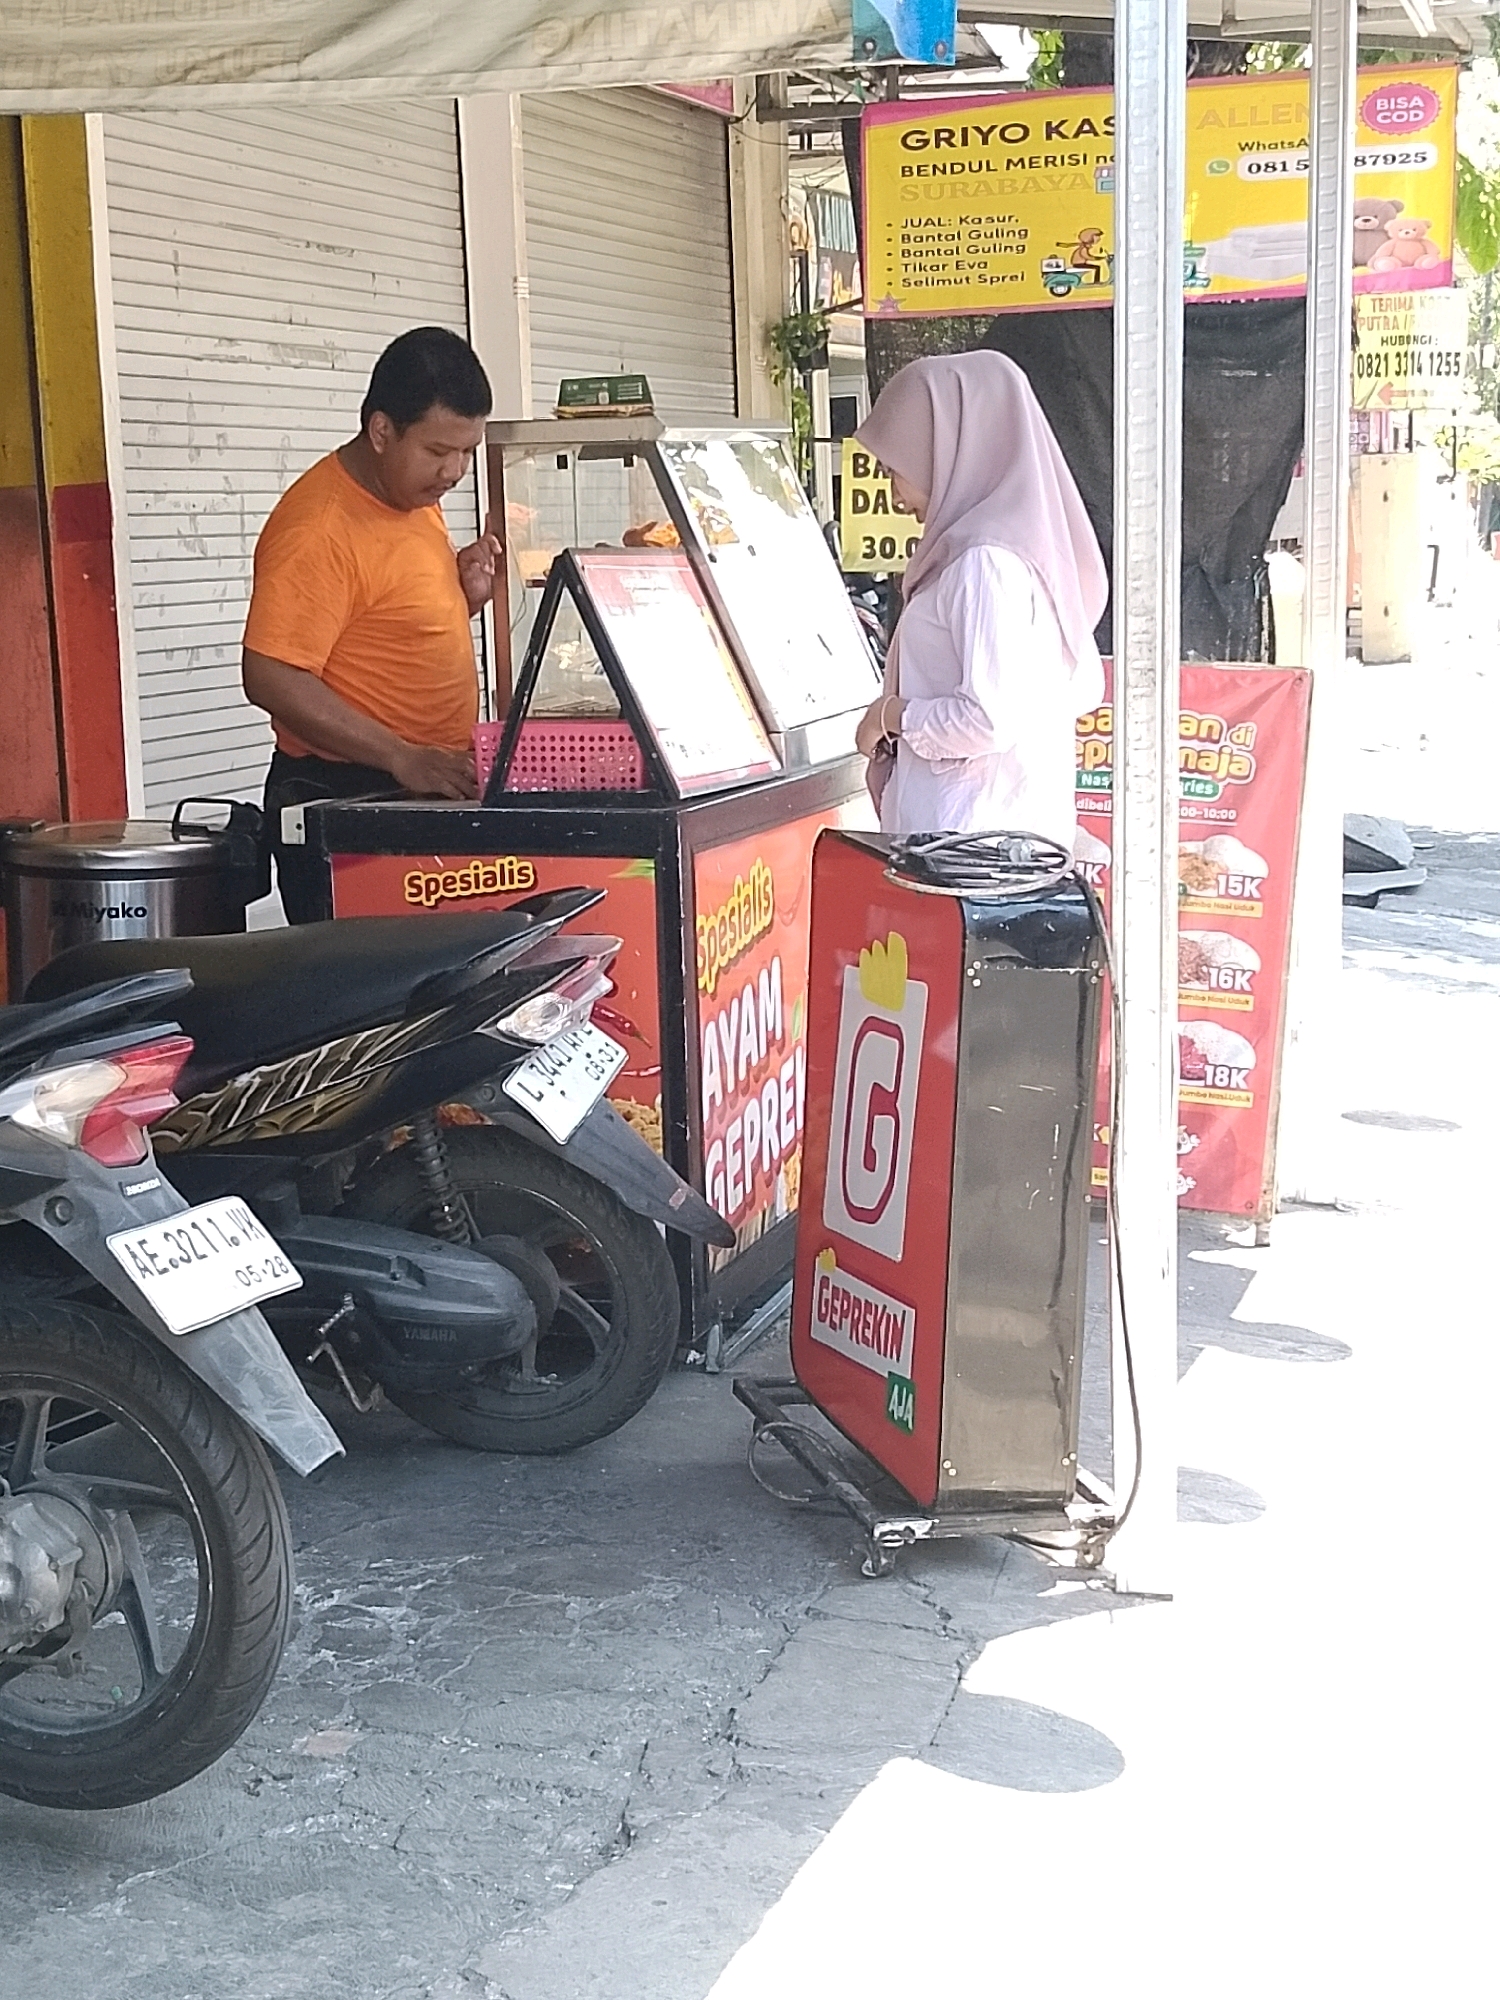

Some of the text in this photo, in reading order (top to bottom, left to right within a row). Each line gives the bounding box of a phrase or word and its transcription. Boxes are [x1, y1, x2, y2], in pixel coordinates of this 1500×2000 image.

[1376, 96, 1424, 111] BISA
[1376, 110, 1424, 124] COD
[900, 122, 1031, 151] GRIYO
[901, 159, 998, 178] BENDUL
[1005, 153, 1088, 171] MERISI
[1354, 151, 1427, 168] 87925
[900, 172, 1093, 201] SURABAYA
[901, 217, 952, 229] JUAL:
[901, 228, 1028, 244] Bantal Guling
[901, 243, 1026, 259] Bantal Guling
[901, 259, 988, 273] Tikar Eva
[901, 271, 1025, 288] Selimut Sprei
[1371, 296, 1414, 313] TERIMA
[1358, 314, 1400, 331] PUTRA
[1357, 352, 1388, 379] 0821
[1429, 350, 1460, 377] 1255
[1230, 725, 1253, 747] di
[406, 857, 532, 905] Spesialis
[1217, 874, 1264, 899] 15K
[697, 859, 773, 992] Spesialis
[1207, 966, 1253, 992] 16K
[702, 956, 782, 1122] AYAM
[1204, 1064, 1249, 1090] 18K
[517, 1081, 544, 1102] L
[841, 1015, 905, 1225] G
[124, 1238, 169, 1279] AE
[163, 1217, 233, 1264] 3211
[817, 1275, 906, 1363] GEPREKIN
[888, 1383, 913, 1431] AJA
